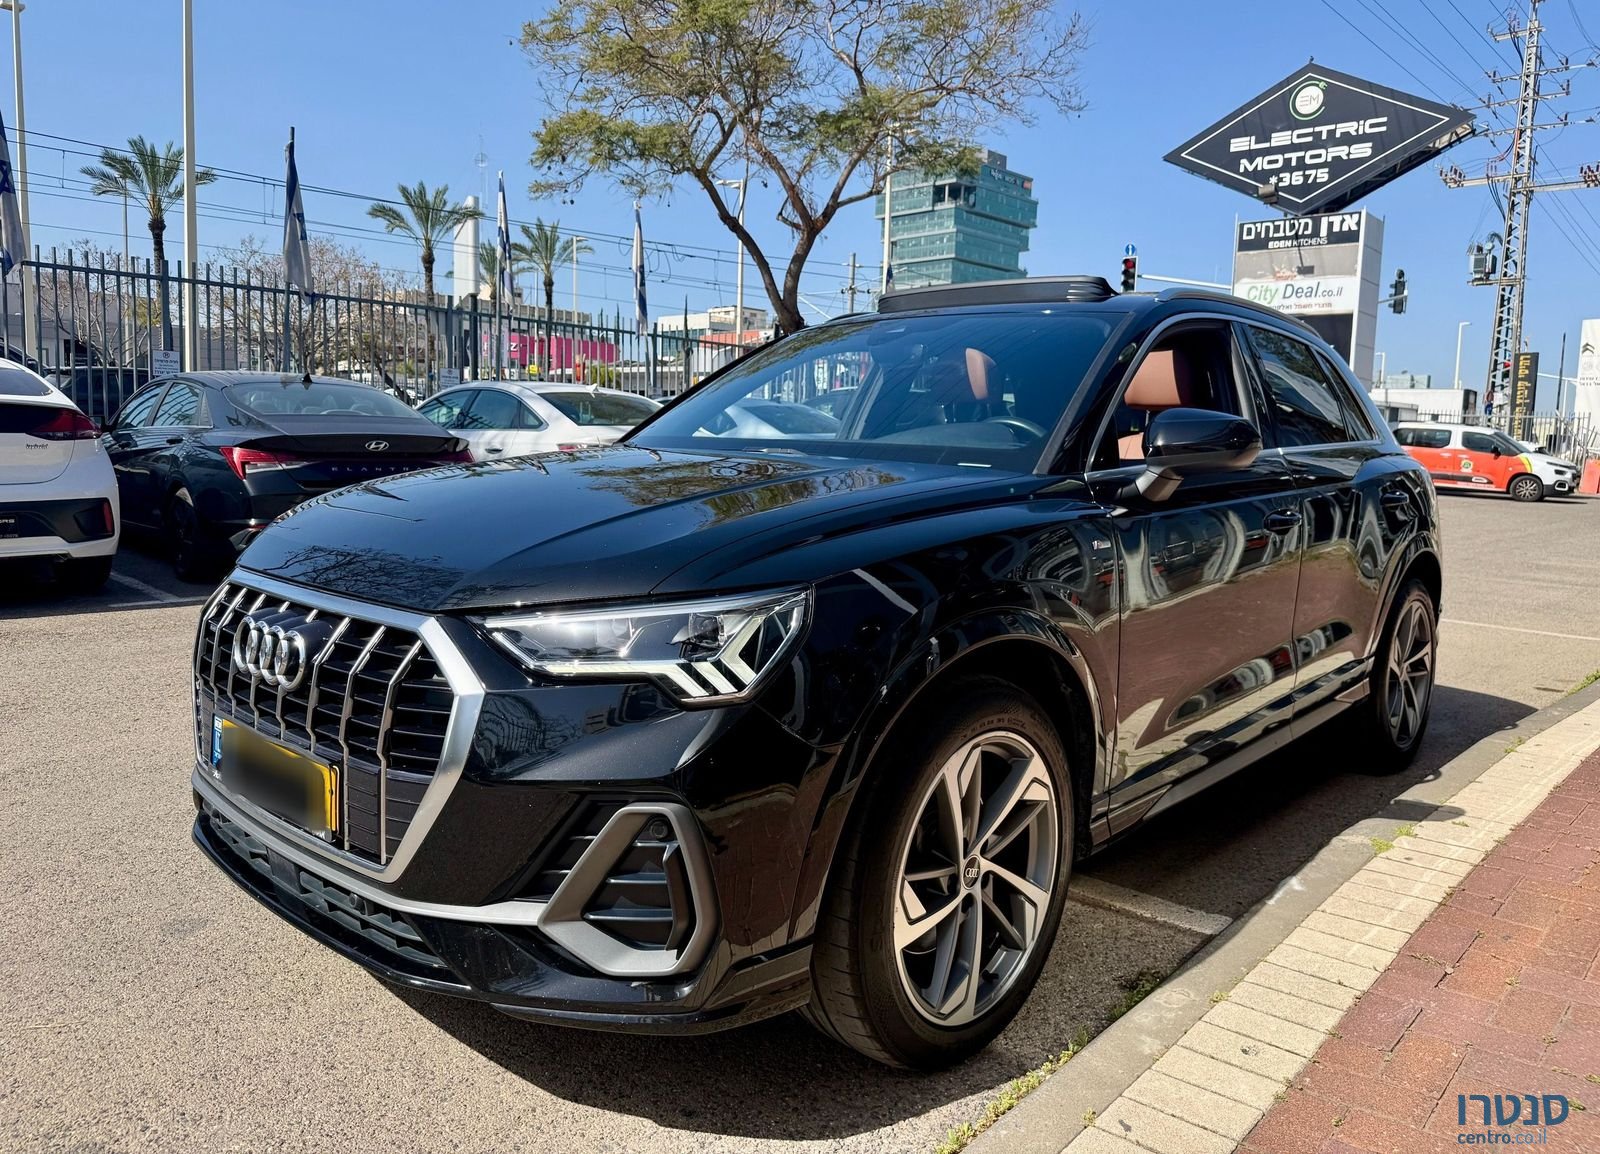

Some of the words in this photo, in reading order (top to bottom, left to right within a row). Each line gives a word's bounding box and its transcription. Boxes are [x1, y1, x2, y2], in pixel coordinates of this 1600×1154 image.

[1229, 116, 1388, 153] ELECTRIC
[1239, 142, 1372, 173] MOTORS
[1242, 218, 1313, 240] מטבחים
[1319, 213, 1360, 237] אדן
[1268, 239, 1292, 249] EDEN
[1292, 237, 1328, 248] KITCHENS
